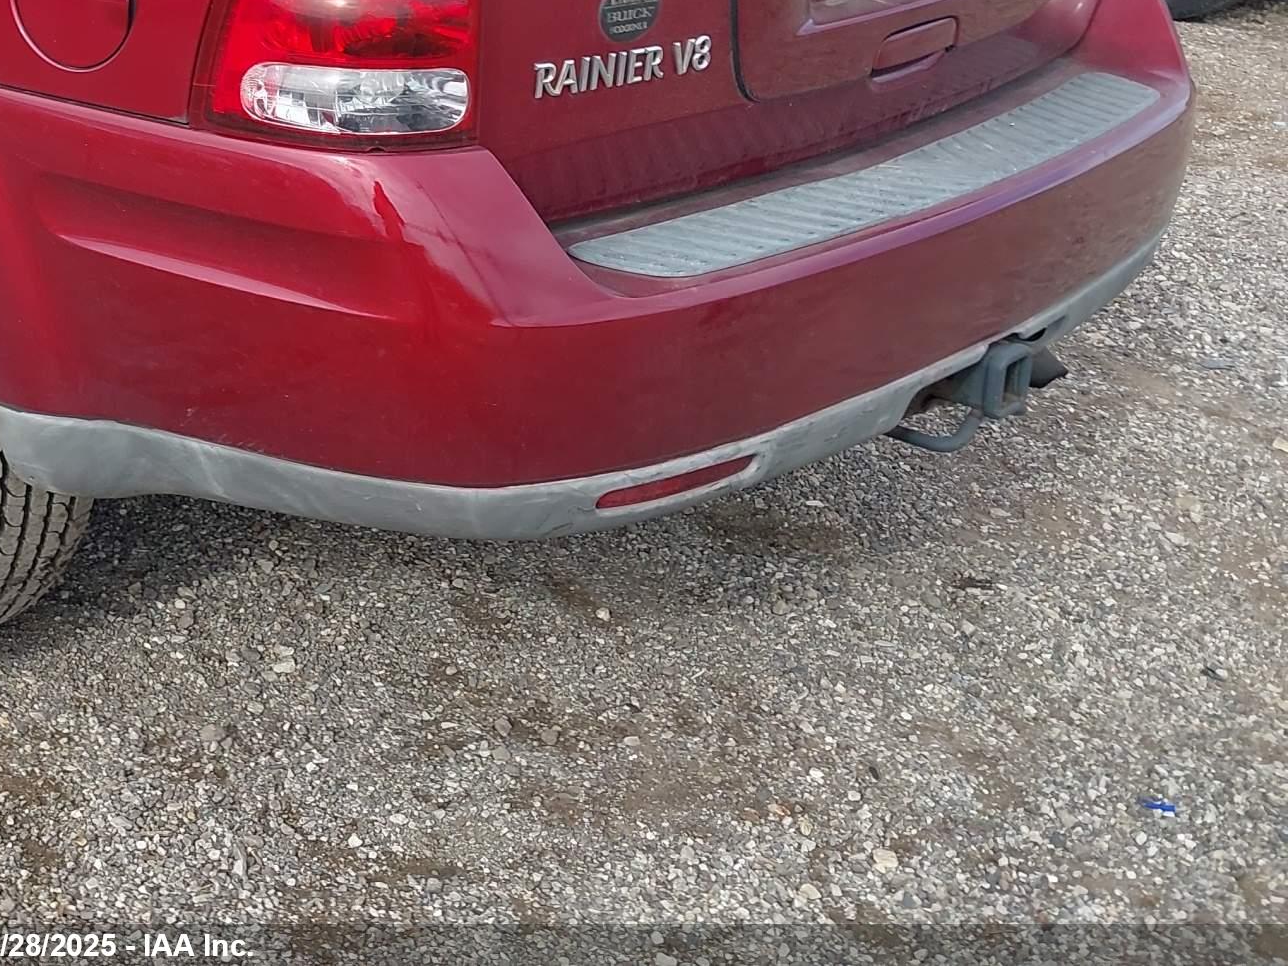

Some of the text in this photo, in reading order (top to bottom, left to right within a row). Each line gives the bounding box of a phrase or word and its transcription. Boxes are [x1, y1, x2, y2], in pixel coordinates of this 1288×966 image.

[607, 7, 652, 23] BUICK
[533, 35, 712, 99] RAINIER V8
